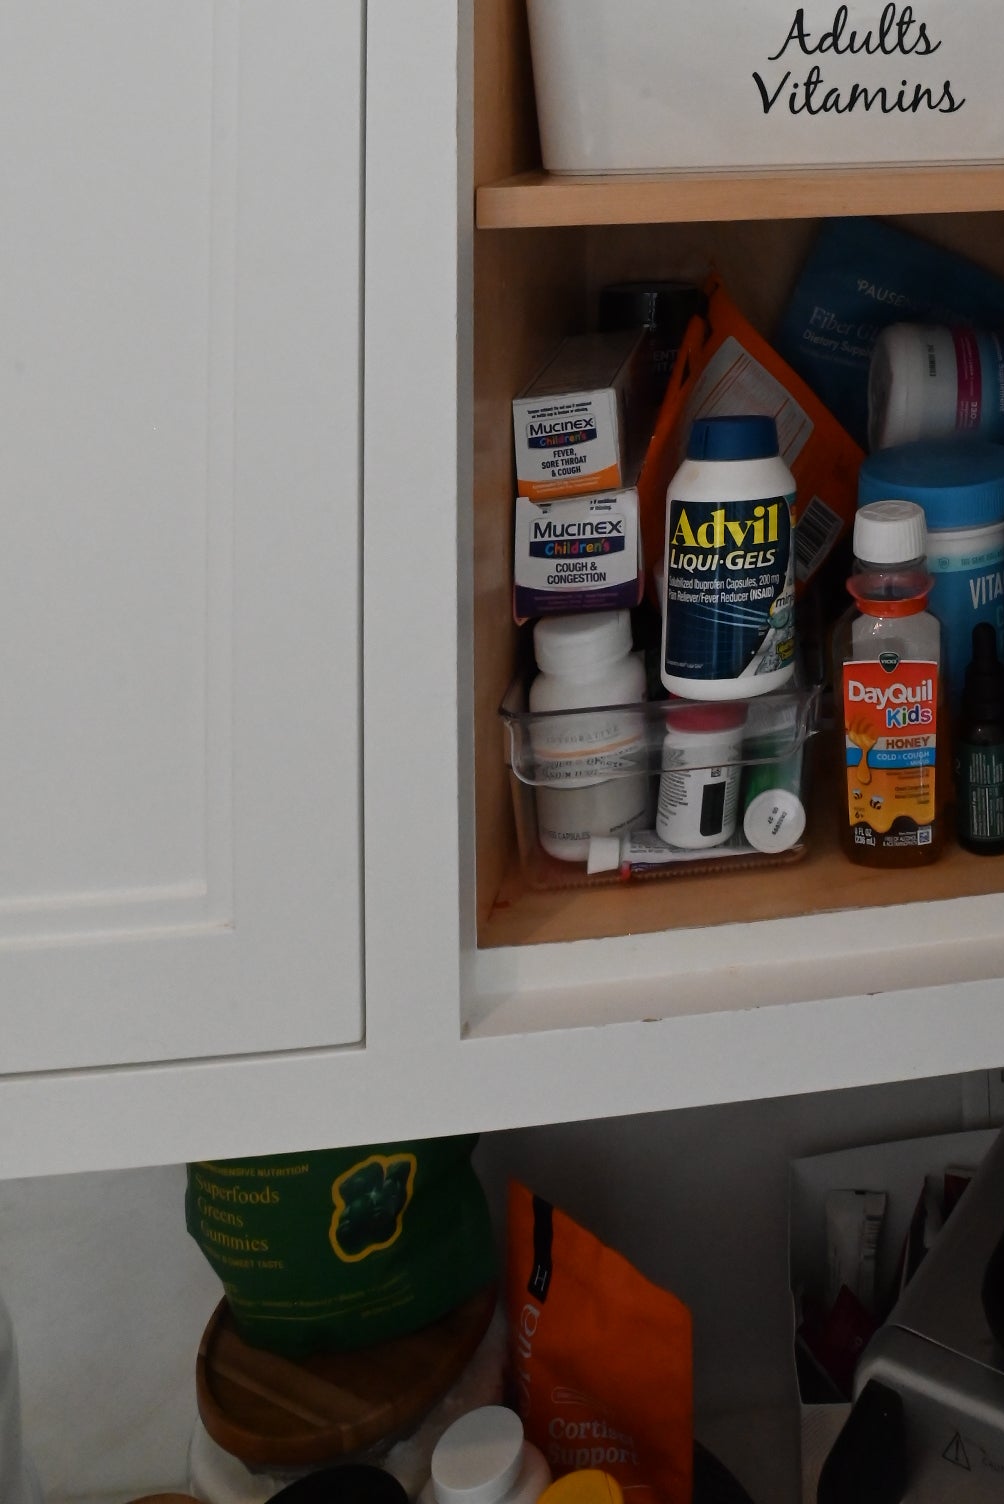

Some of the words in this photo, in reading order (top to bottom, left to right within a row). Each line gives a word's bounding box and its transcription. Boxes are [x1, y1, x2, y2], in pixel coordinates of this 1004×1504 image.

[767, 1, 943, 61] Adults
[751, 65, 966, 116] Vitamins
[808, 305, 852, 336] Fiber
[529, 417, 594, 436] Mucinex
[540, 431, 587, 447] Children's
[541, 459, 560, 470] SORE
[561, 455, 587, 466] THROAT
[553, 448, 577, 459] FEVER,
[557, 466, 582, 476] COUGH
[533, 519, 623, 539] Mucinex
[670, 502, 780, 549] Advil
[544, 537, 611, 556] Children's
[555, 561, 588, 573] COUGH
[589, 561, 598, 571] &
[547, 572, 607, 585] CONGESTION
[694, 578, 725, 591] Ibuprofen
[726, 577, 758, 591] Capsules,
[759, 574, 771, 586] 200
[771, 574, 780, 586] mg
[720, 591, 749, 603] Reducer
[749, 586, 775, 602] (NSAID)
[847, 678, 934, 710] DayQuil
[886, 704, 933, 729] Kids
[886, 735, 930, 750] HONEY
[876, 753, 897, 761] COLD
[902, 751, 930, 761] COUGH
[195, 1173, 280, 1204] Superfoods
[197, 1197, 245, 1227] Greens
[200, 1220, 270, 1252] Gummies
[549, 1440, 640, 1469] Support
